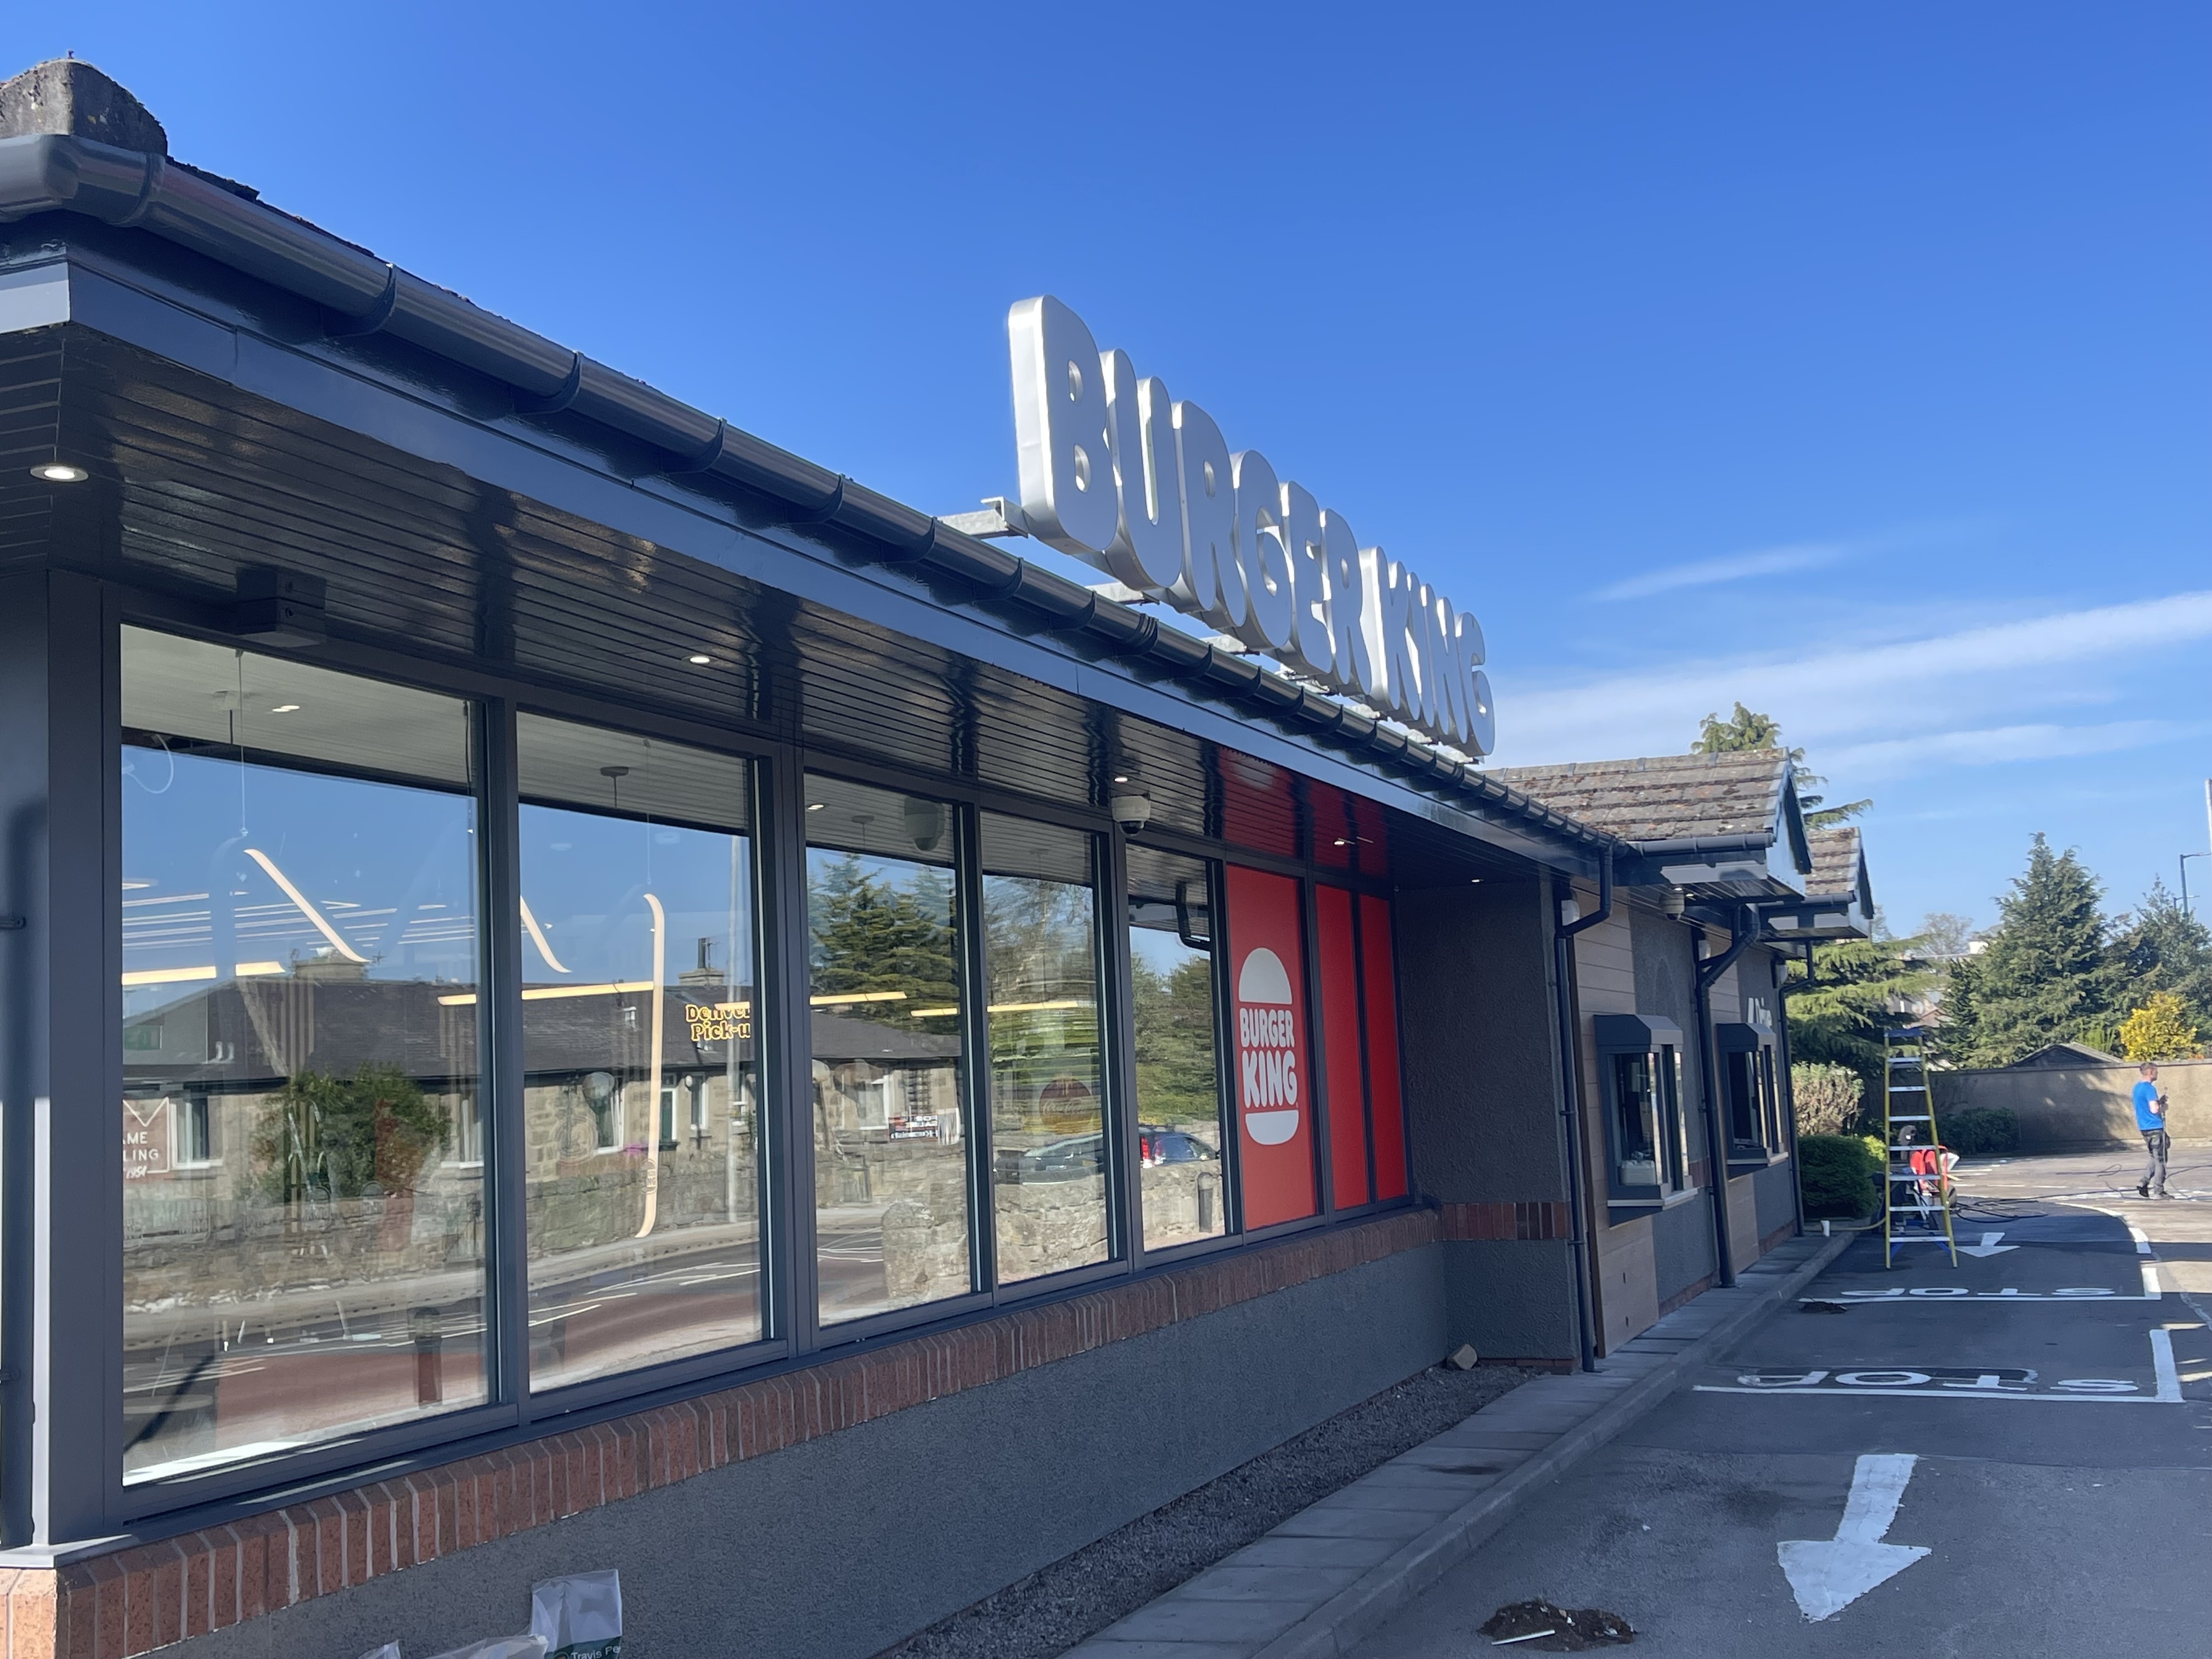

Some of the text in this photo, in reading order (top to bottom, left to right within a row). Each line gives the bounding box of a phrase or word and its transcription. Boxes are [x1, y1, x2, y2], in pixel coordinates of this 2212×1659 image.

[1008, 295, 1496, 758] BURGER KING
[1239, 1008, 1295, 1048] BURGER
[1242, 1050, 1297, 1108] KING
[1841, 1288, 2115, 1296] STOP
[1737, 1370, 2139, 1392] STOP
